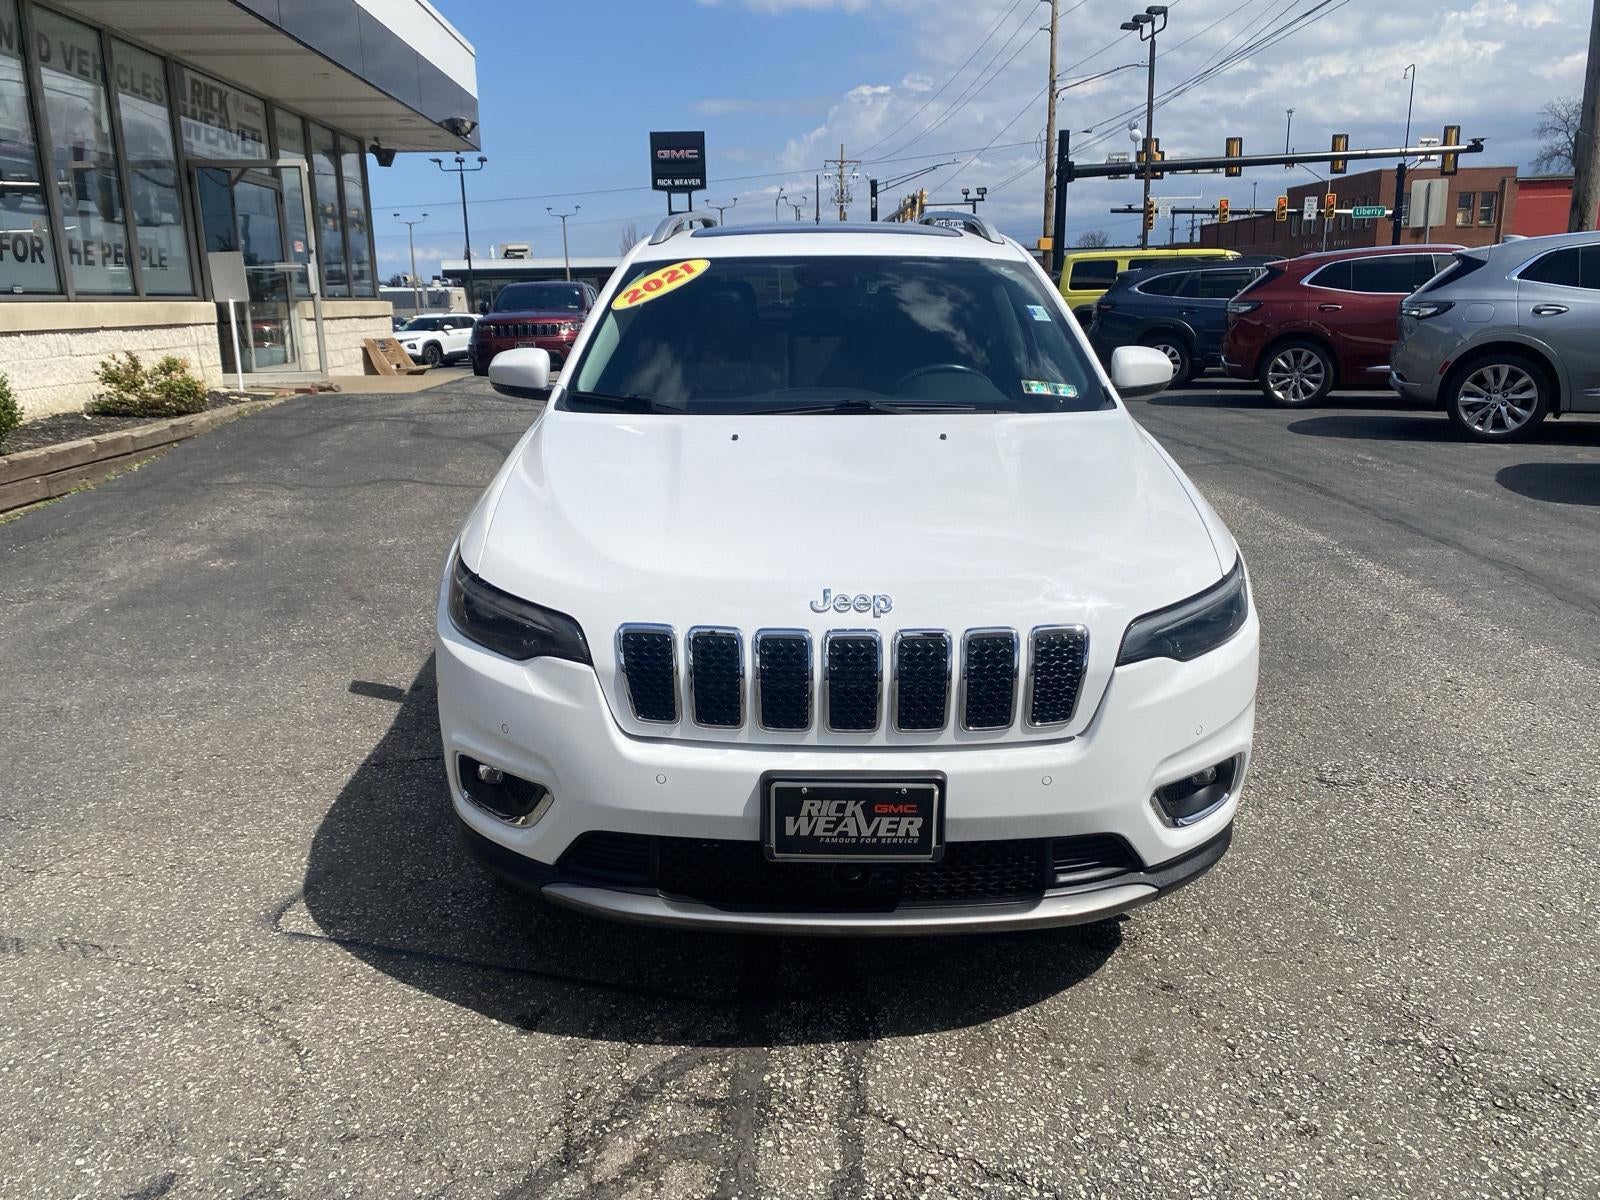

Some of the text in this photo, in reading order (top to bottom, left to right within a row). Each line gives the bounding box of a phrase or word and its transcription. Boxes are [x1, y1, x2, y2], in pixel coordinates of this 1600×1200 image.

[0, 17, 164, 102] ND VEHCLES
[189, 78, 229, 114] RICK
[657, 149, 699, 159] GMC
[657, 178, 701, 186] RICK WEAVER
[1356, 207, 1382, 217] Liberty
[0, 233, 46, 265] FOR
[68, 239, 96, 267] HE
[622, 263, 697, 305] 2021
[809, 588, 894, 618] Jeep
[799, 799, 918, 817] RICK GMC
[785, 816, 923, 838] WEAVER
[819, 837, 920, 845] FAMOUS FOR SERVICE
